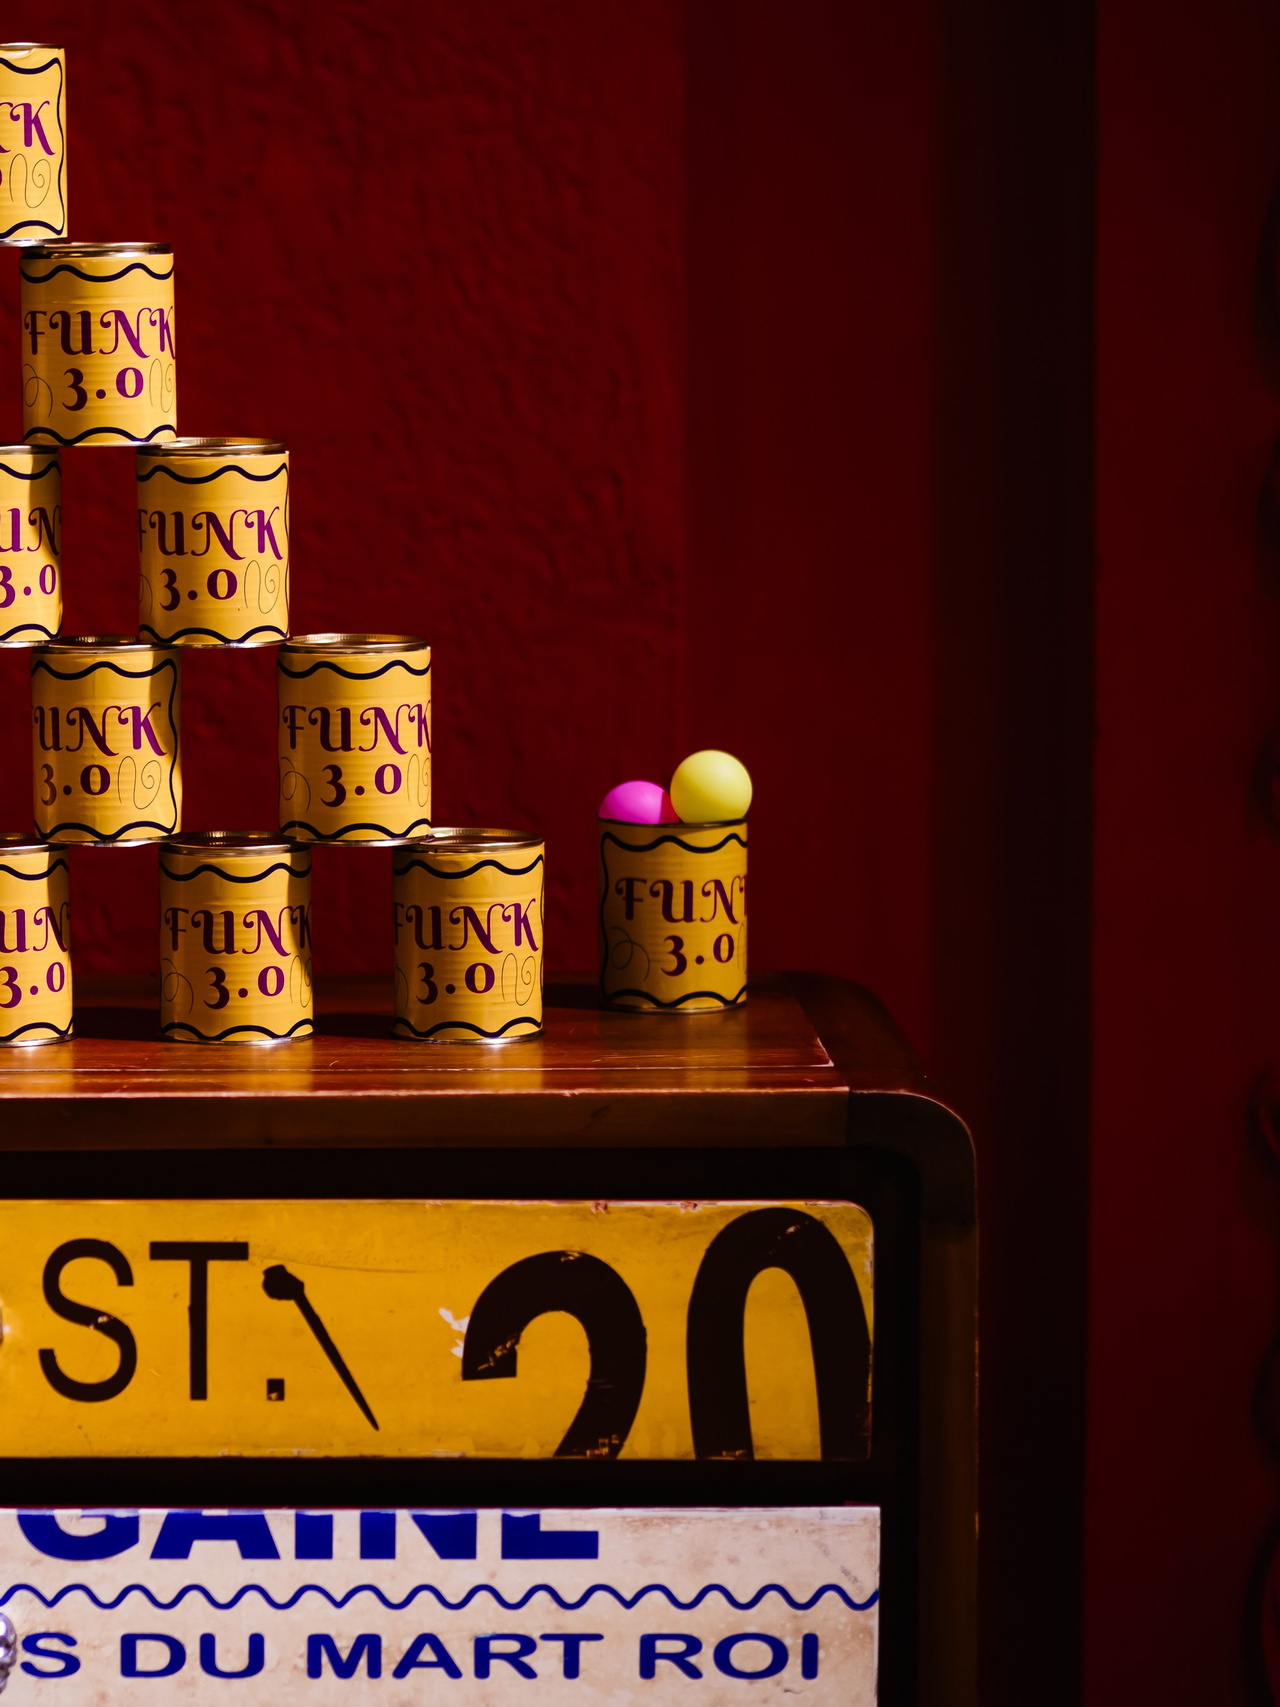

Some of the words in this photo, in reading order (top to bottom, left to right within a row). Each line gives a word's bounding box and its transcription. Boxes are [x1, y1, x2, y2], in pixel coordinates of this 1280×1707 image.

[24, 306, 176, 359] FUNK
[62, 367, 144, 411] 3.0
[159, 568, 238, 611] 3.0
[32, 702, 168, 757] UNK
[282, 700, 431, 755] FUNK
[40, 763, 111, 806] 3.0
[320, 763, 402, 808] 3.0
[615, 875, 747, 924] FUN
[660, 933, 734, 977] 3.0
[203, 965, 285, 1010] 3.0
[415, 962, 495, 1005] 3.0
[38, 1238, 285, 1403] ST.
[121, 1633, 265, 1679] DU
[306, 1633, 604, 1680] MART
[639, 1633, 818, 1680] ROI
